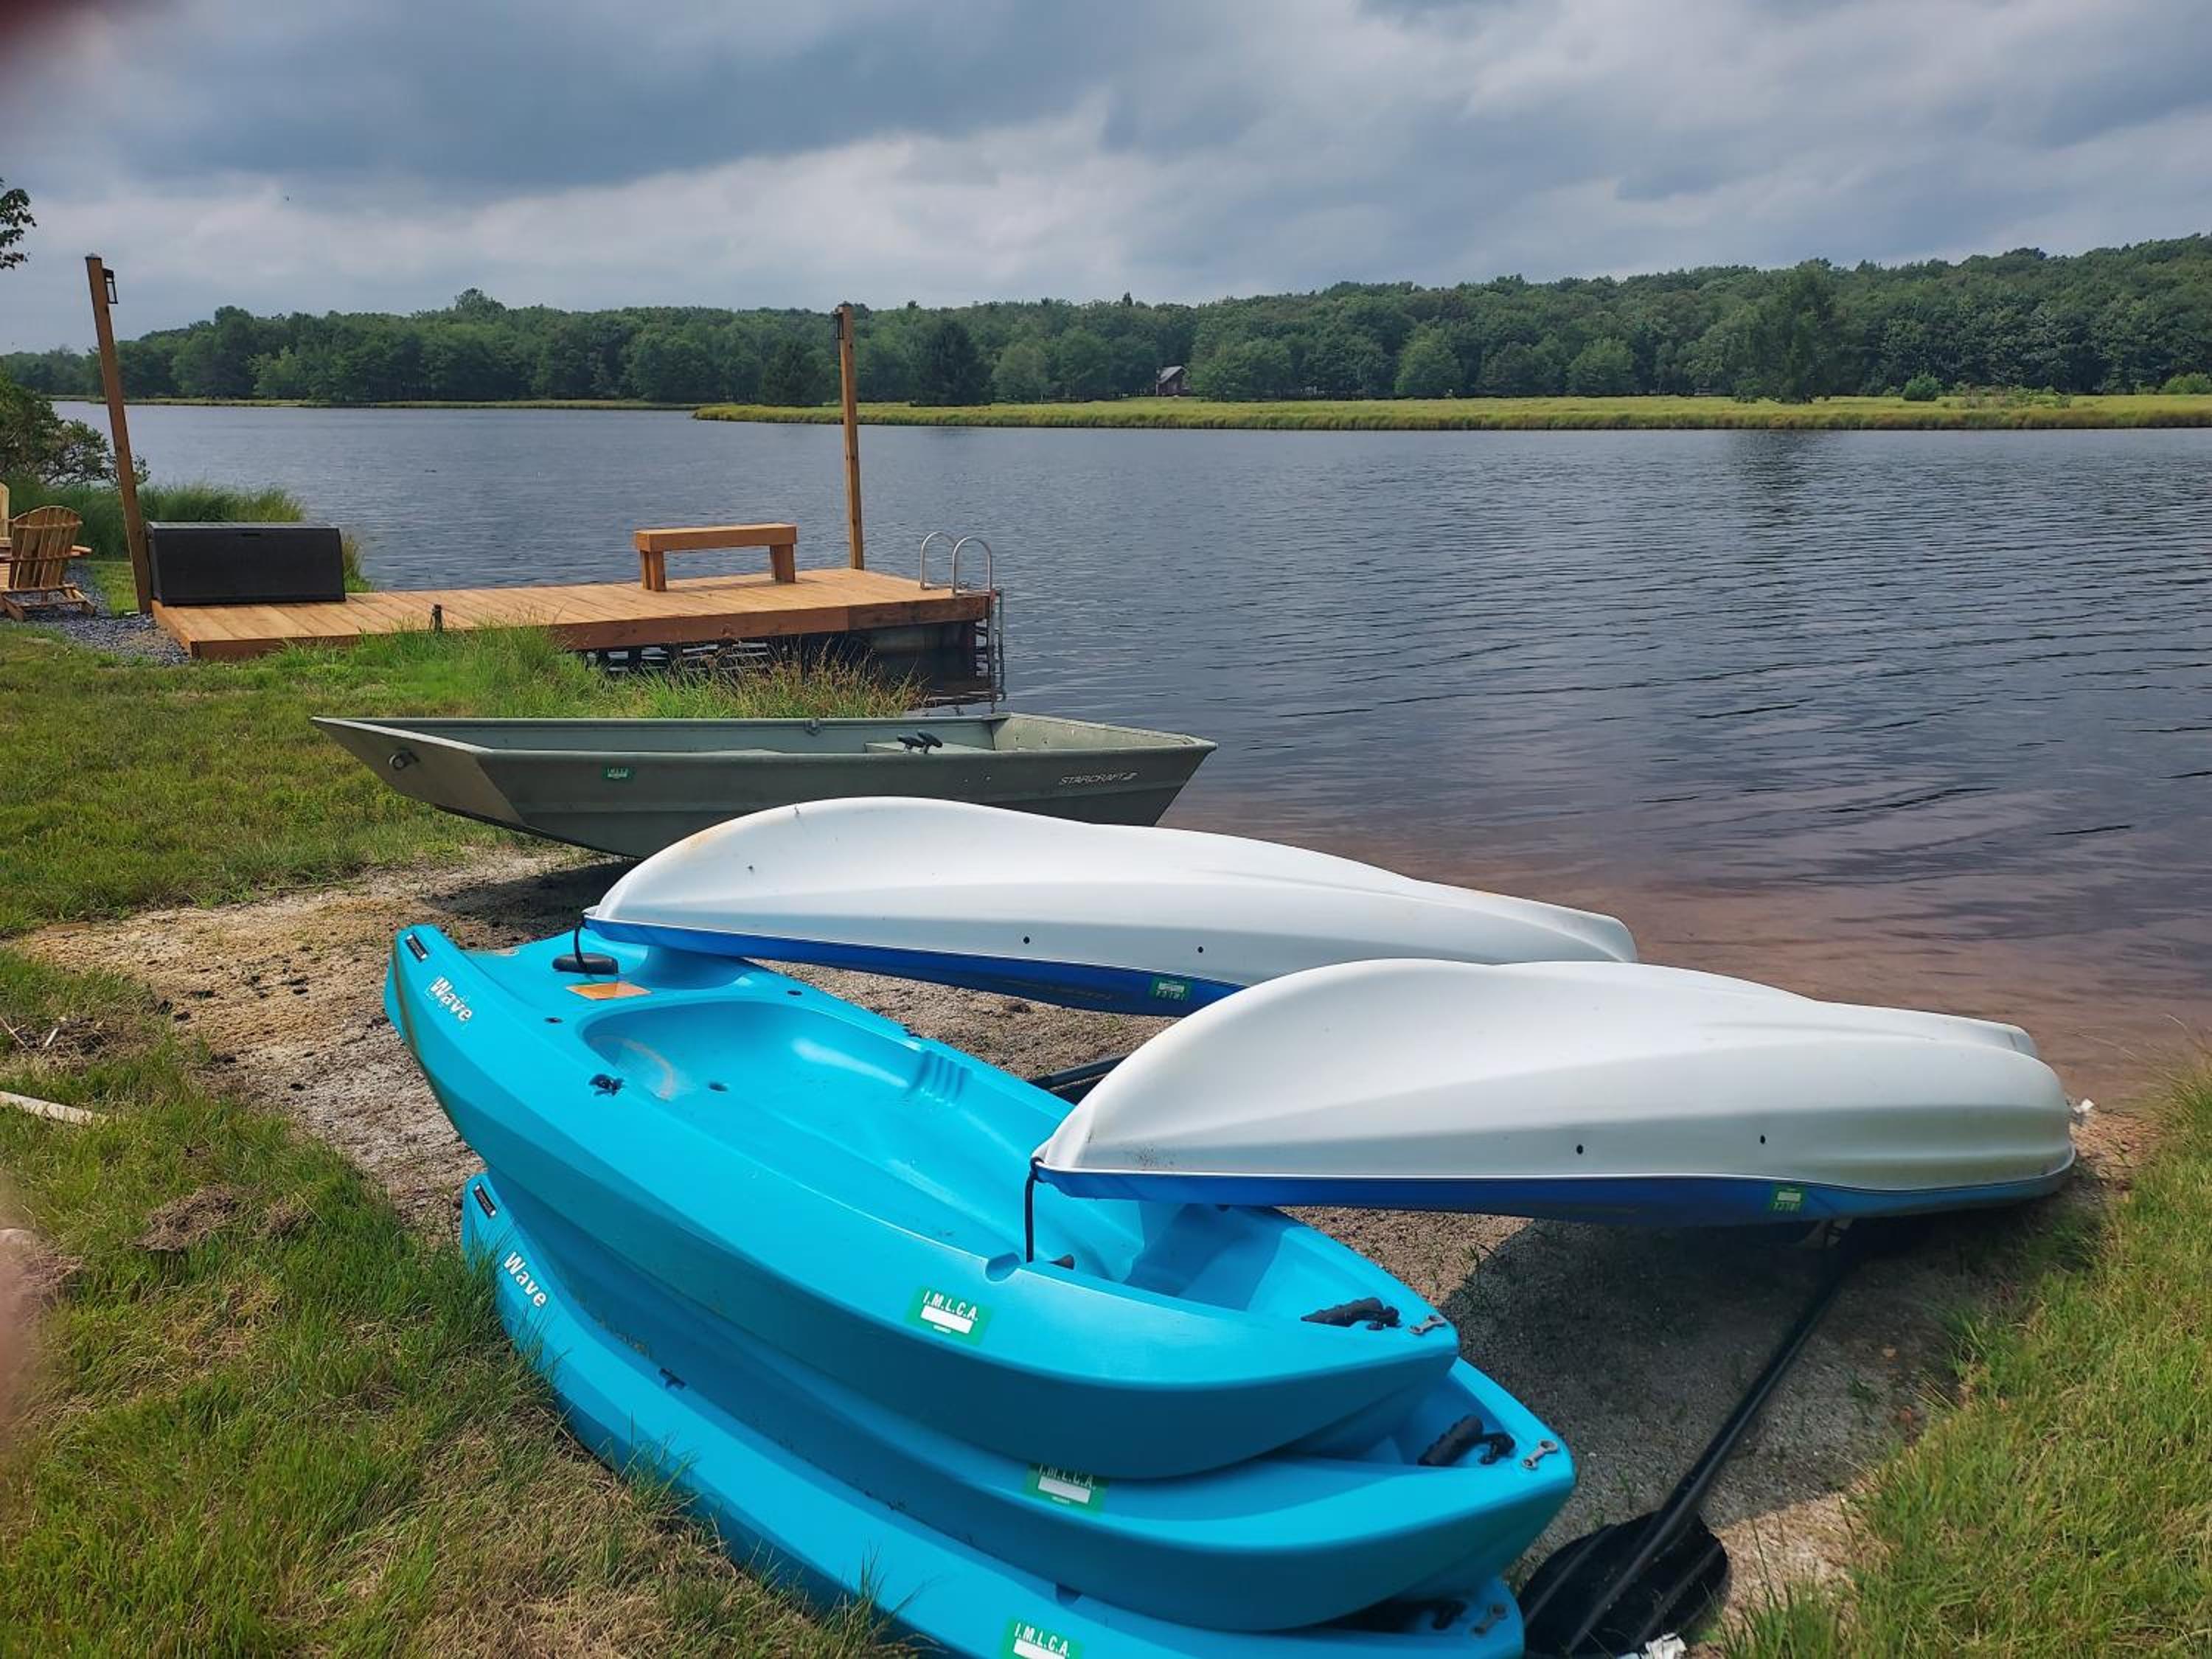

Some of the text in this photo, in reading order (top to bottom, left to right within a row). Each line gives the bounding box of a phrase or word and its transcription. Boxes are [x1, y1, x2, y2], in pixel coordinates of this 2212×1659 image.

[430, 976, 473, 1021] Wave
[504, 1251, 546, 1307] Wave
[922, 1290, 978, 1321] I.M.L.C.A.
[1015, 1622, 1070, 1658] I.M.L.C.A.
